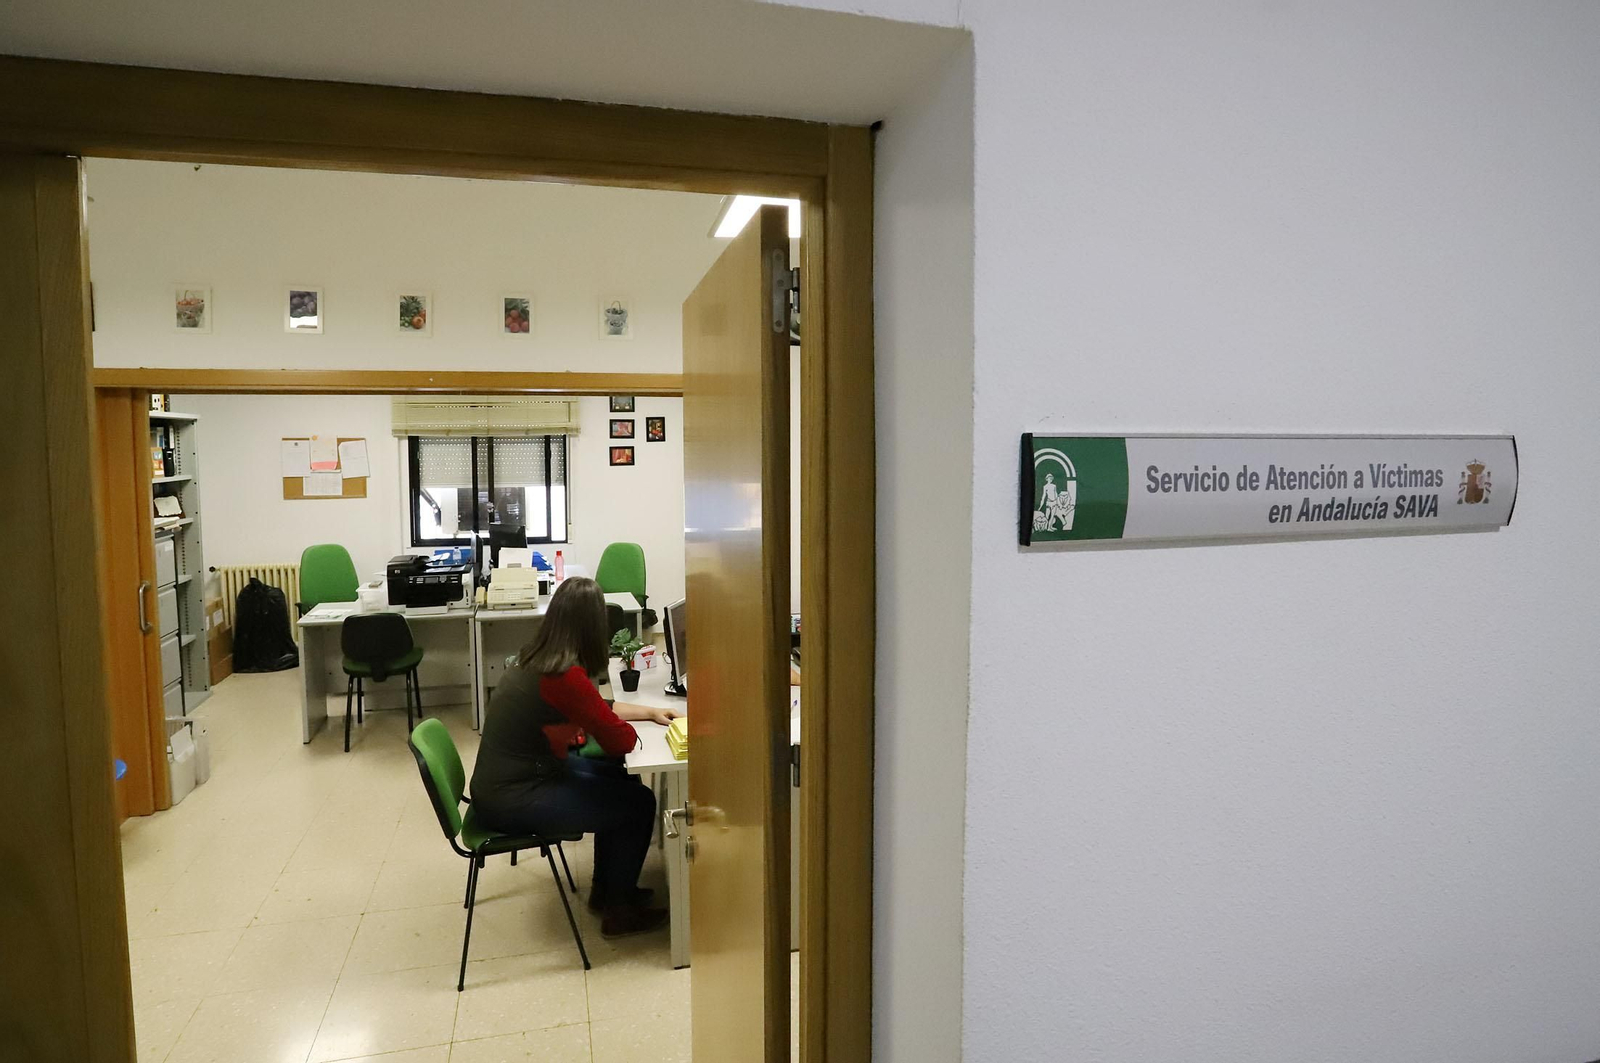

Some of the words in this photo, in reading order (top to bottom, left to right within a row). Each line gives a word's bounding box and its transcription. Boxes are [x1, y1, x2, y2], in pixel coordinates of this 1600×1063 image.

[1145, 464, 1230, 494] Servicio
[1236, 465, 1260, 492] de
[1265, 463, 1348, 491] Atención
[1353, 469, 1365, 490] a
[1368, 462, 1444, 489] Víctimas
[1268, 503, 1292, 523] en
[1295, 495, 1389, 523] Andalucía
[1392, 493, 1440, 520] SAVA
